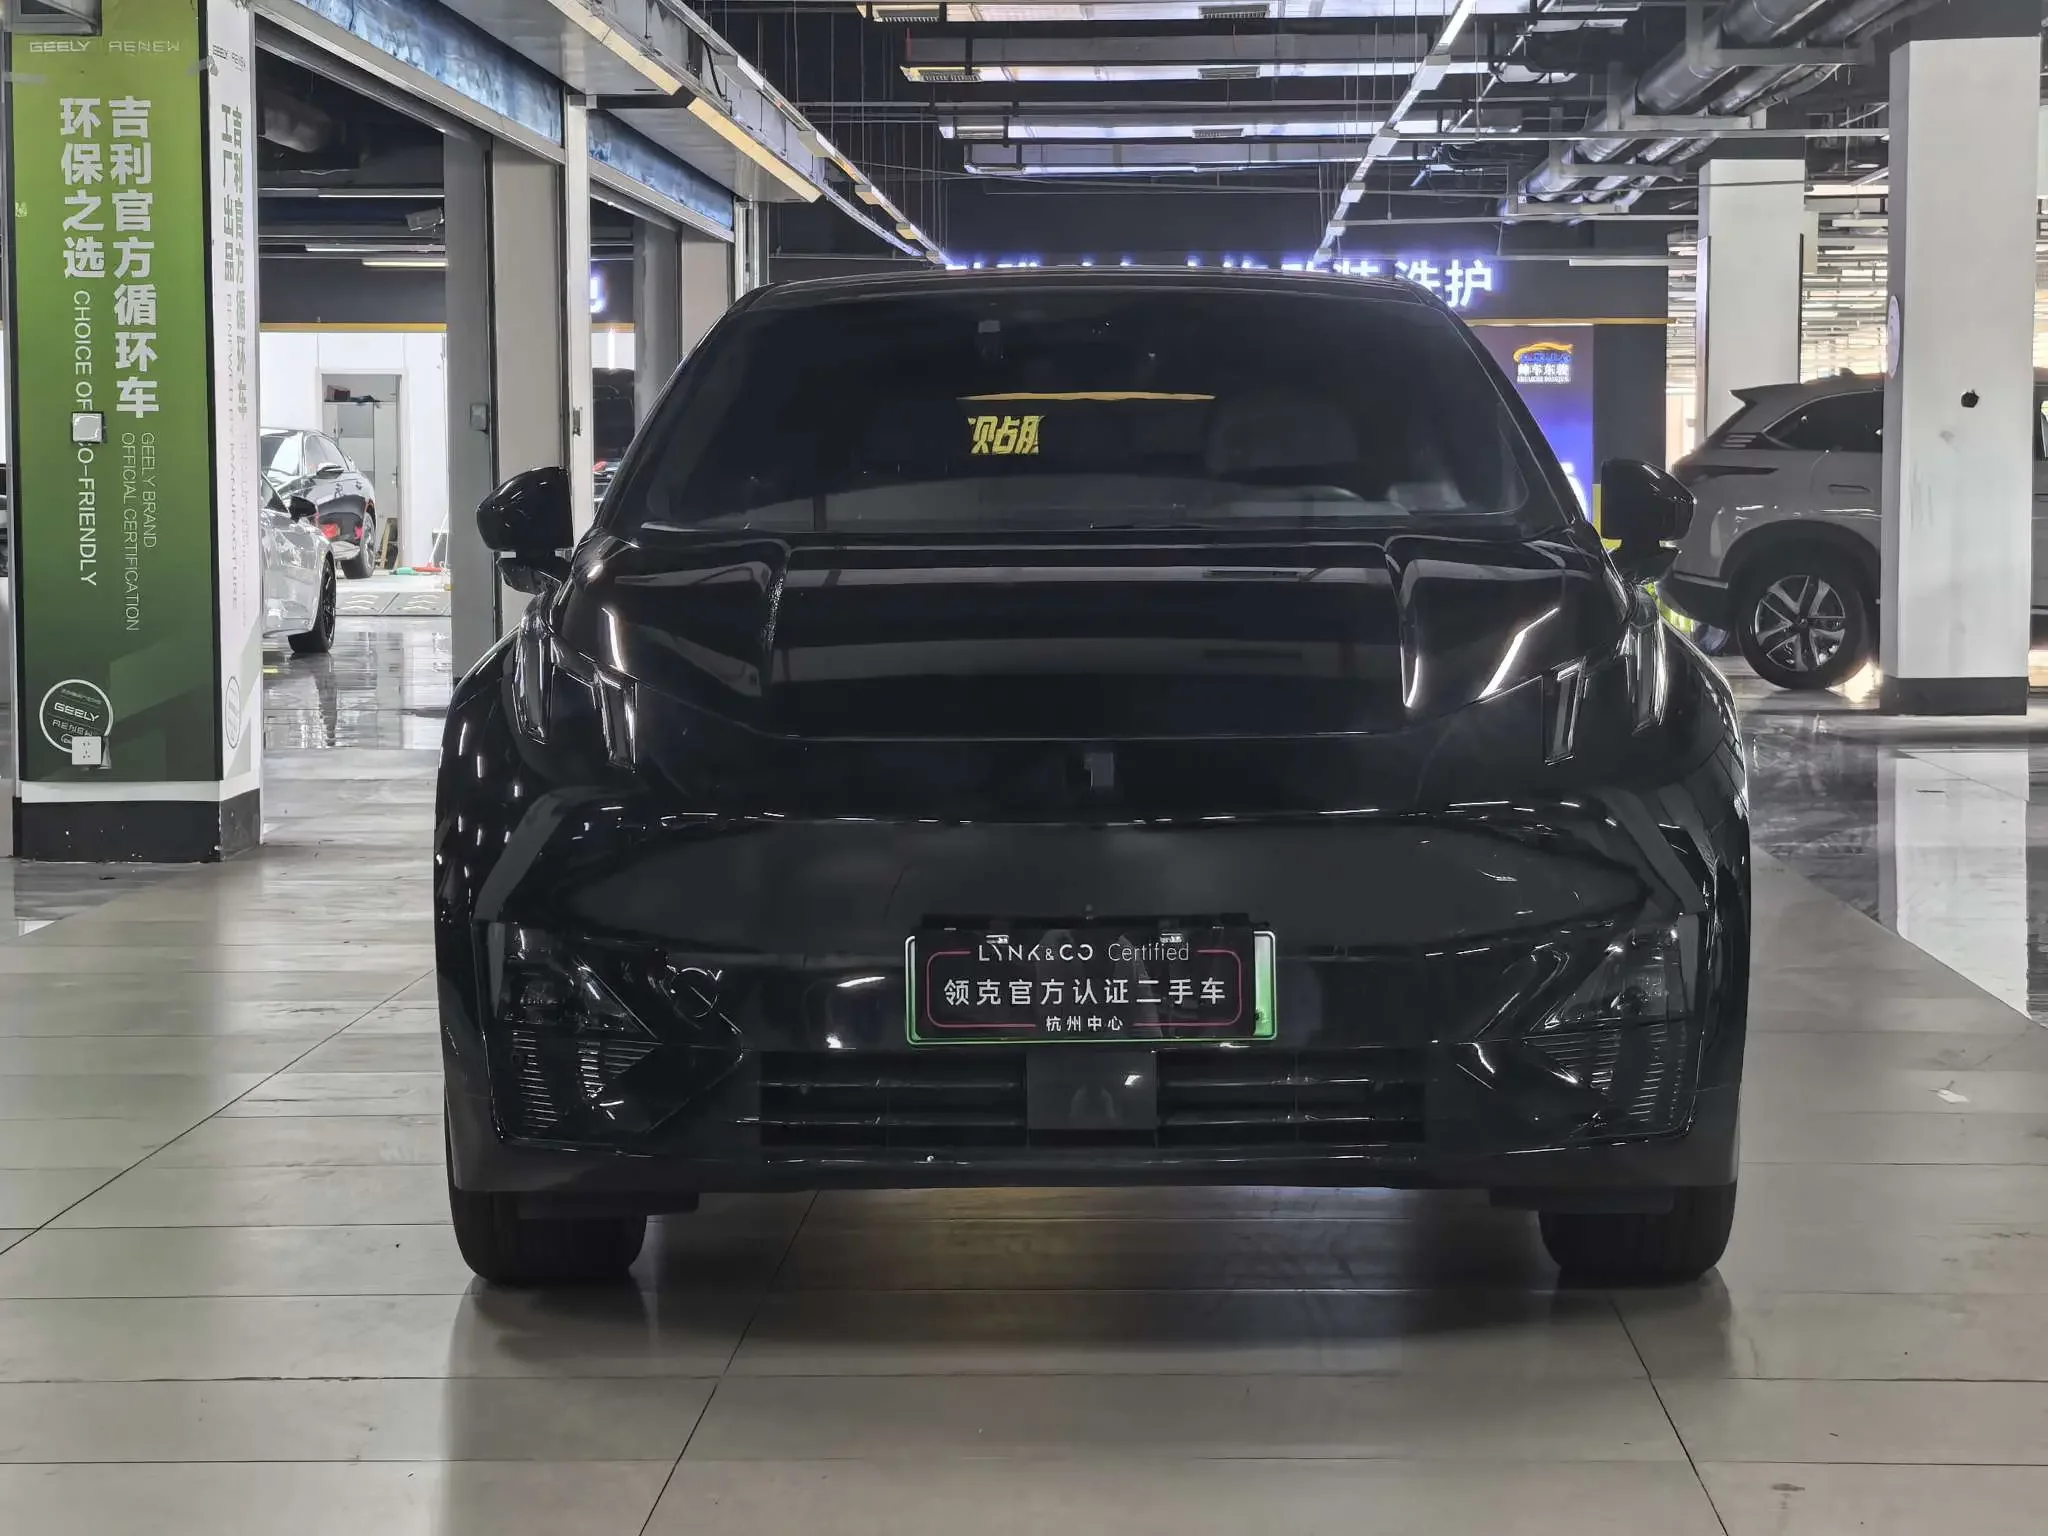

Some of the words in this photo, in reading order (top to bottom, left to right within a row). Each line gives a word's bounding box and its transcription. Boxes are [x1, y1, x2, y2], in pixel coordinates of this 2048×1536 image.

[30, 41, 91, 52] GEELY
[109, 41, 180, 52] RENEW
[59, 97, 106, 280] 环保之选
[221, 103, 235, 283] 工厂出品
[108, 95, 160, 419] 吉利官方循环车
[232, 105, 248, 421] 吉利官方循环车
[73, 289, 93, 376] CHOICE
[75, 381, 93, 411] OF
[121, 431, 137, 505] OFFICIAL
[141, 431, 156, 489] GEELY
[77, 442, 97, 586] O-FRIENDLY
[142, 490, 158, 548] BRAND
[123, 507, 141, 631] CERTIFICATION
[53, 701, 100, 722] GEELY
[1107, 942, 1190, 962] Certified
[943, 977, 1226, 1006] 领克官方认证二手车
[1045, 1014, 1124, 1032] 杭州中心
